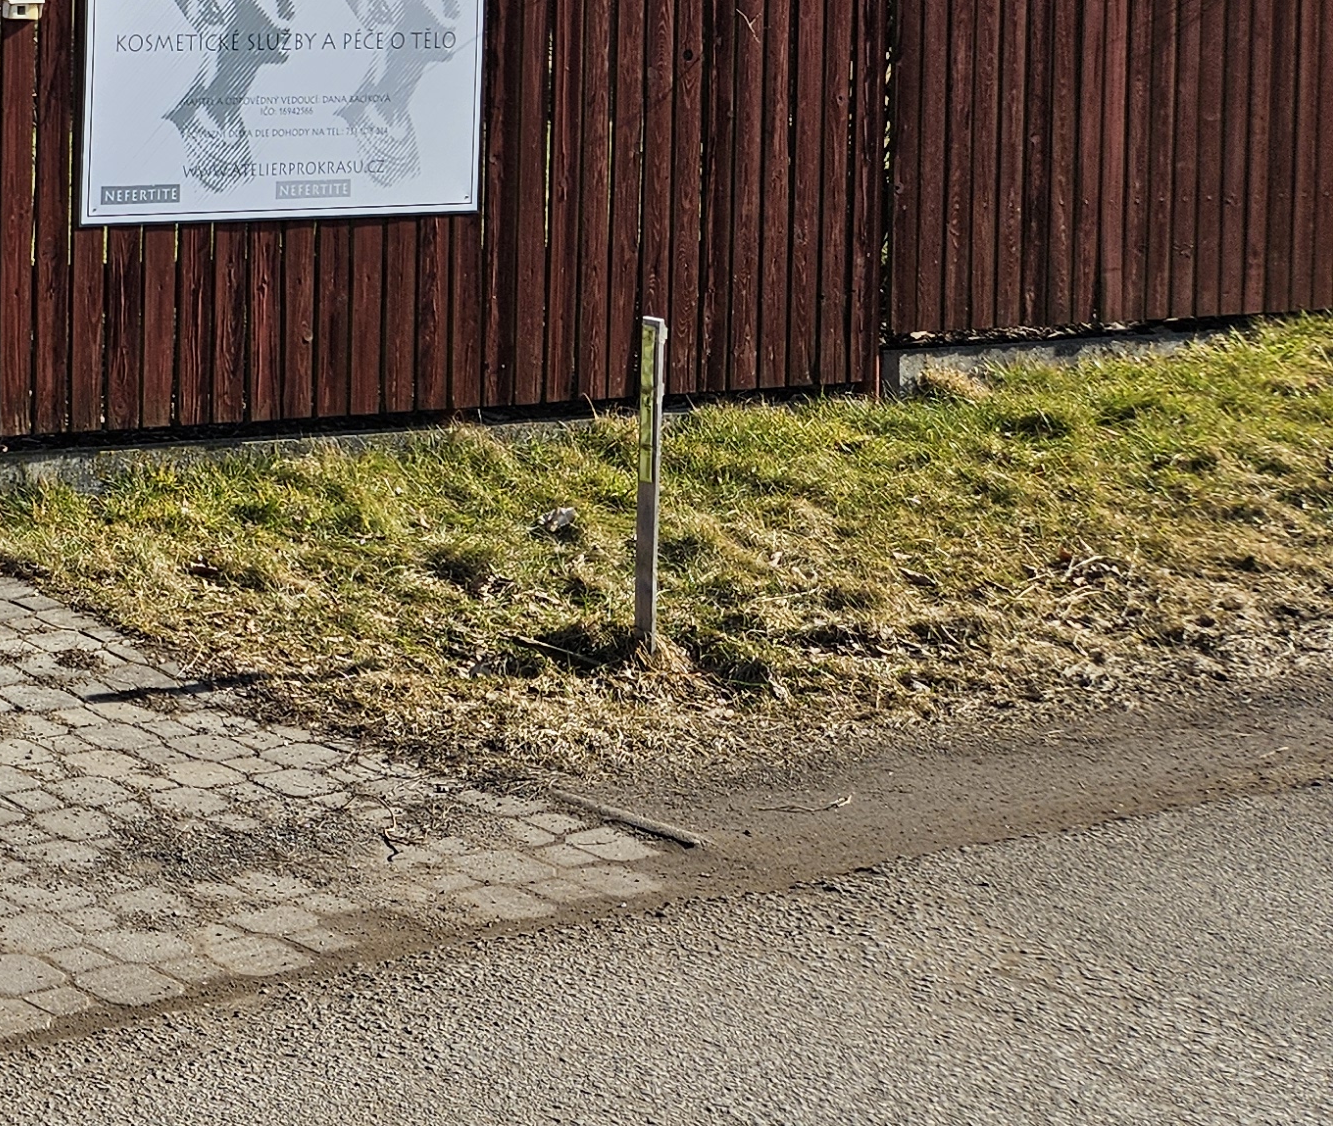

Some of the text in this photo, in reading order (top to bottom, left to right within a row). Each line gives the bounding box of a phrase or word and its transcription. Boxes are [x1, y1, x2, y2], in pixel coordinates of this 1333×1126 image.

[116, 26, 457, 53] KOSMETICKÉ SLUŽBY A PÉČE O TĚLO
[322, 95, 347, 104] DANA
[255, 128, 270, 138] DLE
[272, 128, 310, 137] DOHODY
[312, 128, 325, 136] NA
[104, 187, 178, 202] NEFERTITE
[279, 182, 349, 197] NEFERTITE
